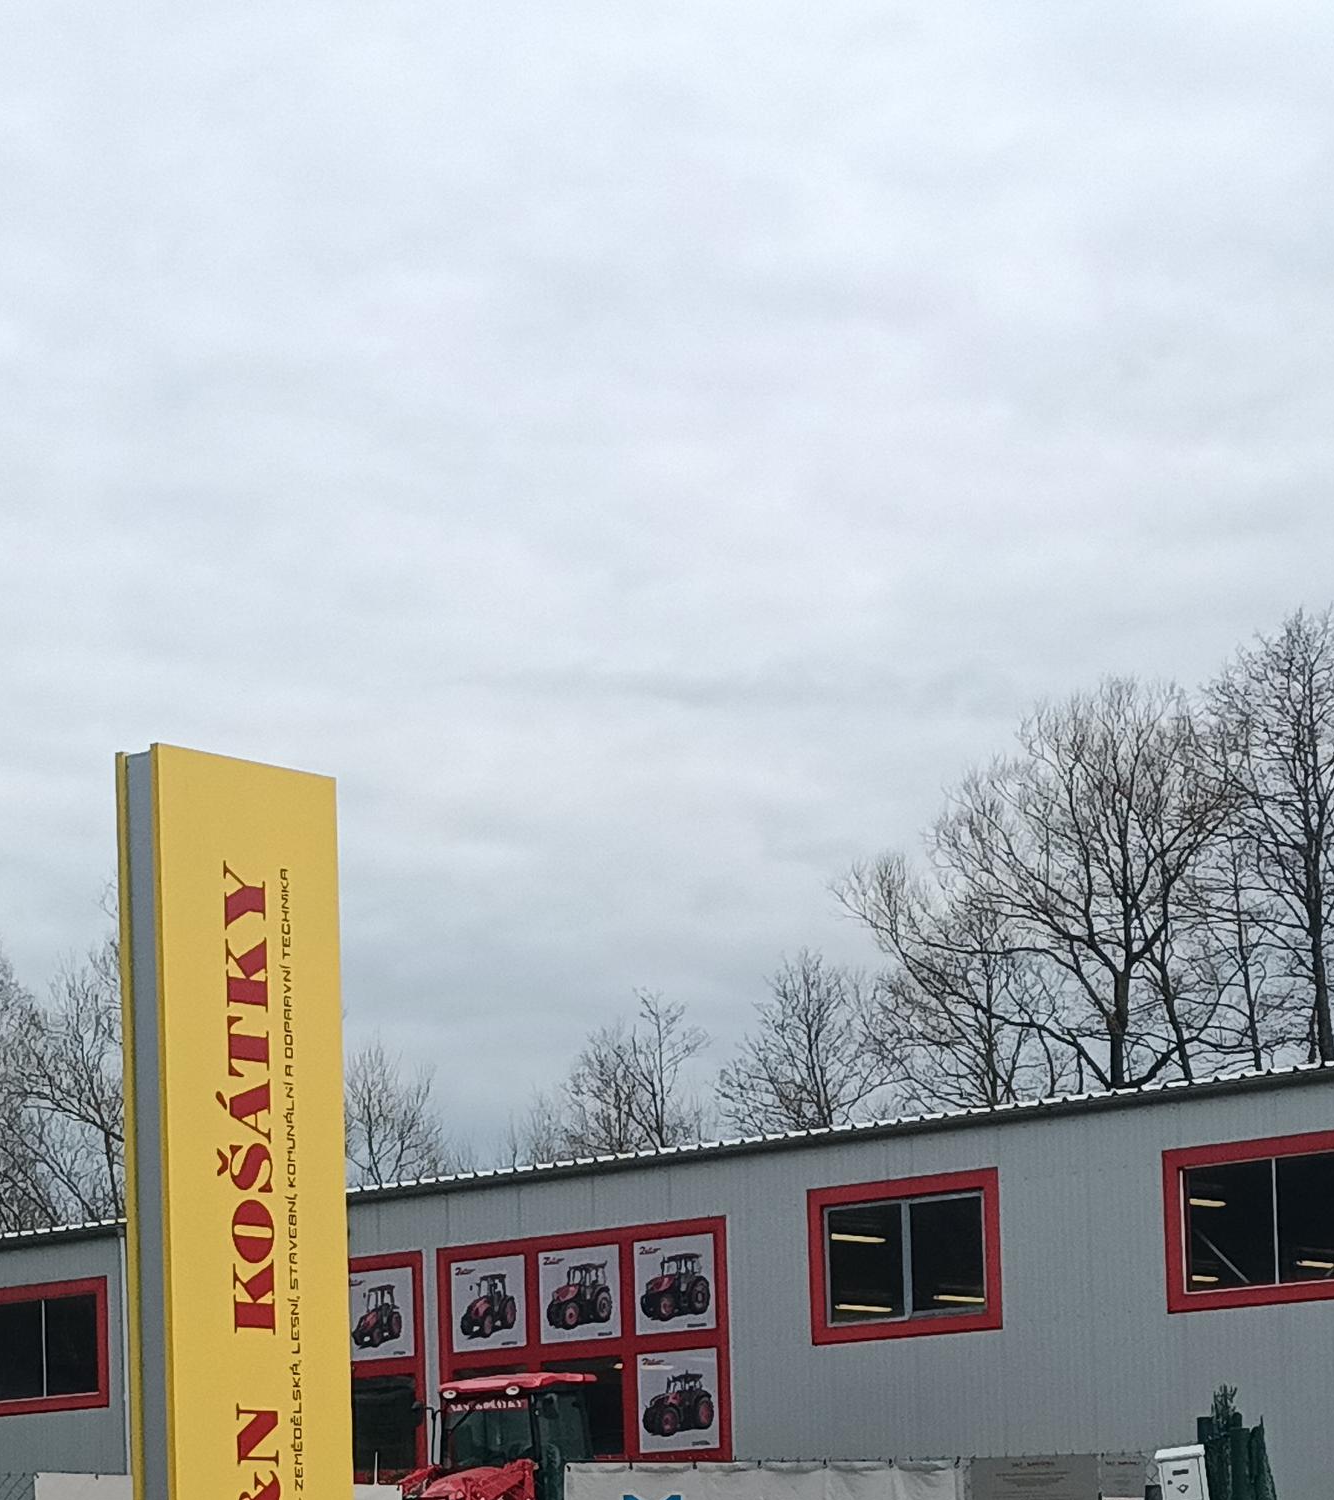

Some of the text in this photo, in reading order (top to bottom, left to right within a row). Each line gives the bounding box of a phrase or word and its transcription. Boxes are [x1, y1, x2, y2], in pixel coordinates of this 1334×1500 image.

[279, 867, 291, 961] TECHNIKA
[280, 963, 294, 1061] DOPRAVNÍ
[215, 859, 276, 1337] KOŠÁTKY
[282, 1080, 296, 1190] KOMUNÁLNÍ
[285, 1193, 299, 1291] STAVEBNÍ,
[288, 1295, 301, 1355] LESNÍ,
